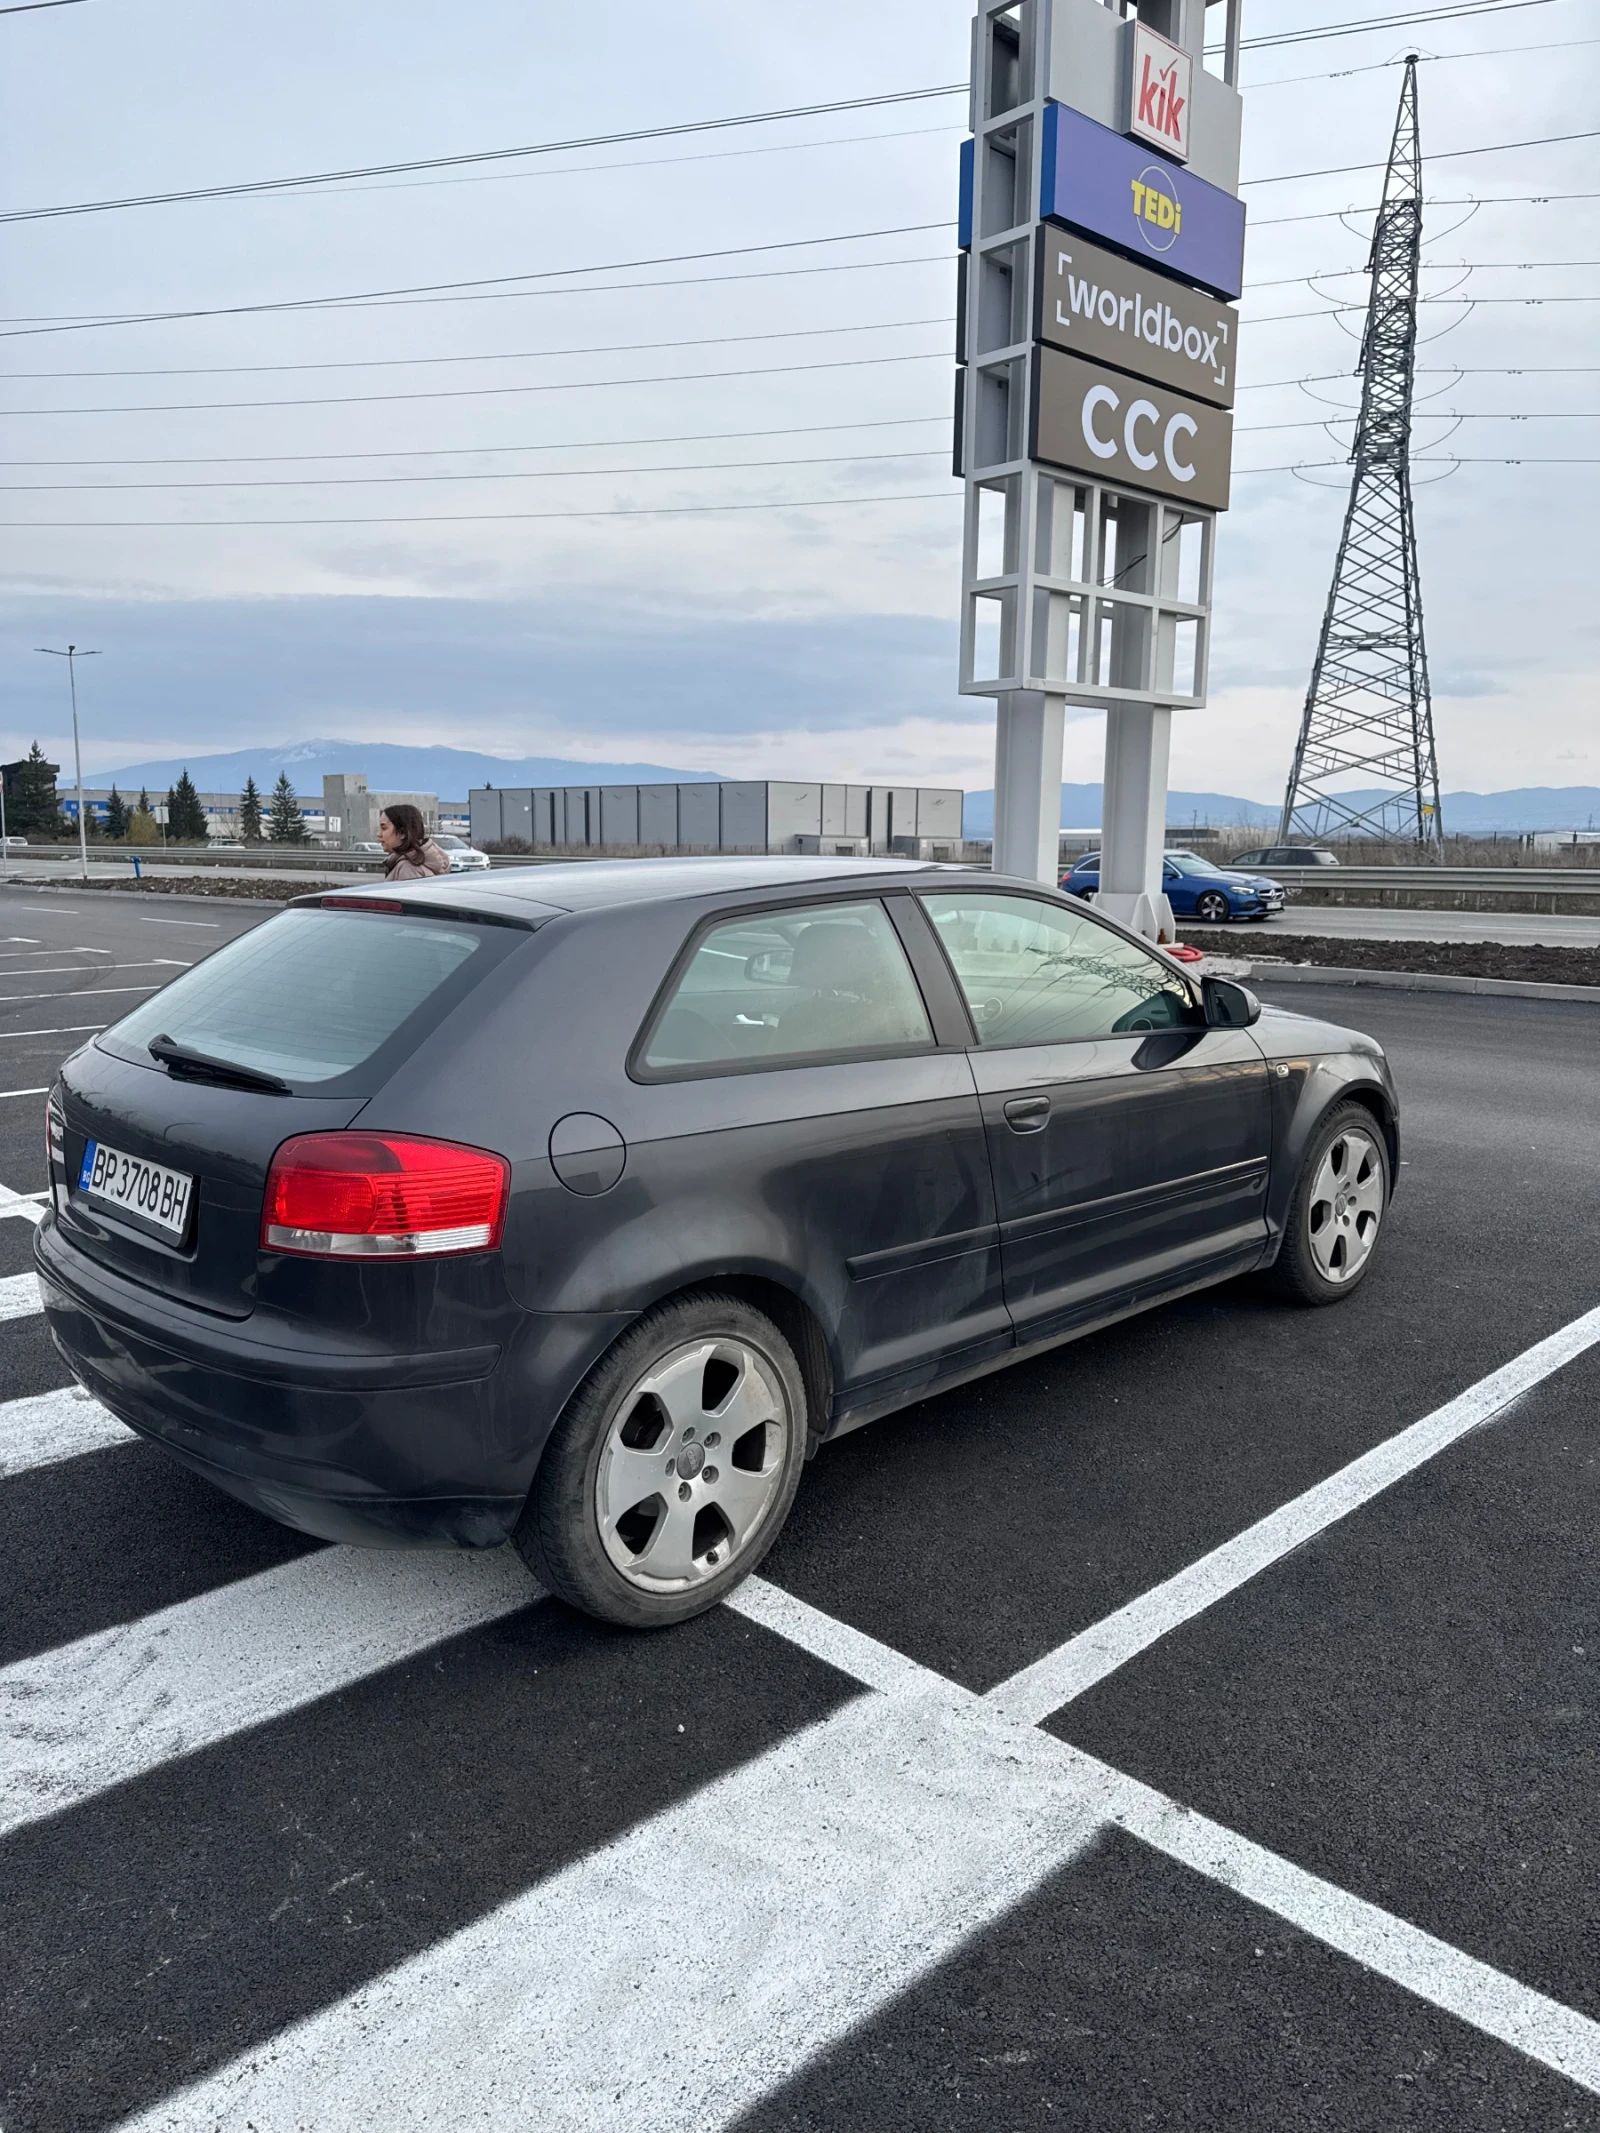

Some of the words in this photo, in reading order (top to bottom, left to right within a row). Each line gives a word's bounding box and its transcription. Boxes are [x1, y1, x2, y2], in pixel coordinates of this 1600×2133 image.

[1131, 179, 1181, 235] TEDi
[1068, 274, 1219, 368] worldbox
[1081, 384, 1198, 482] CCC
